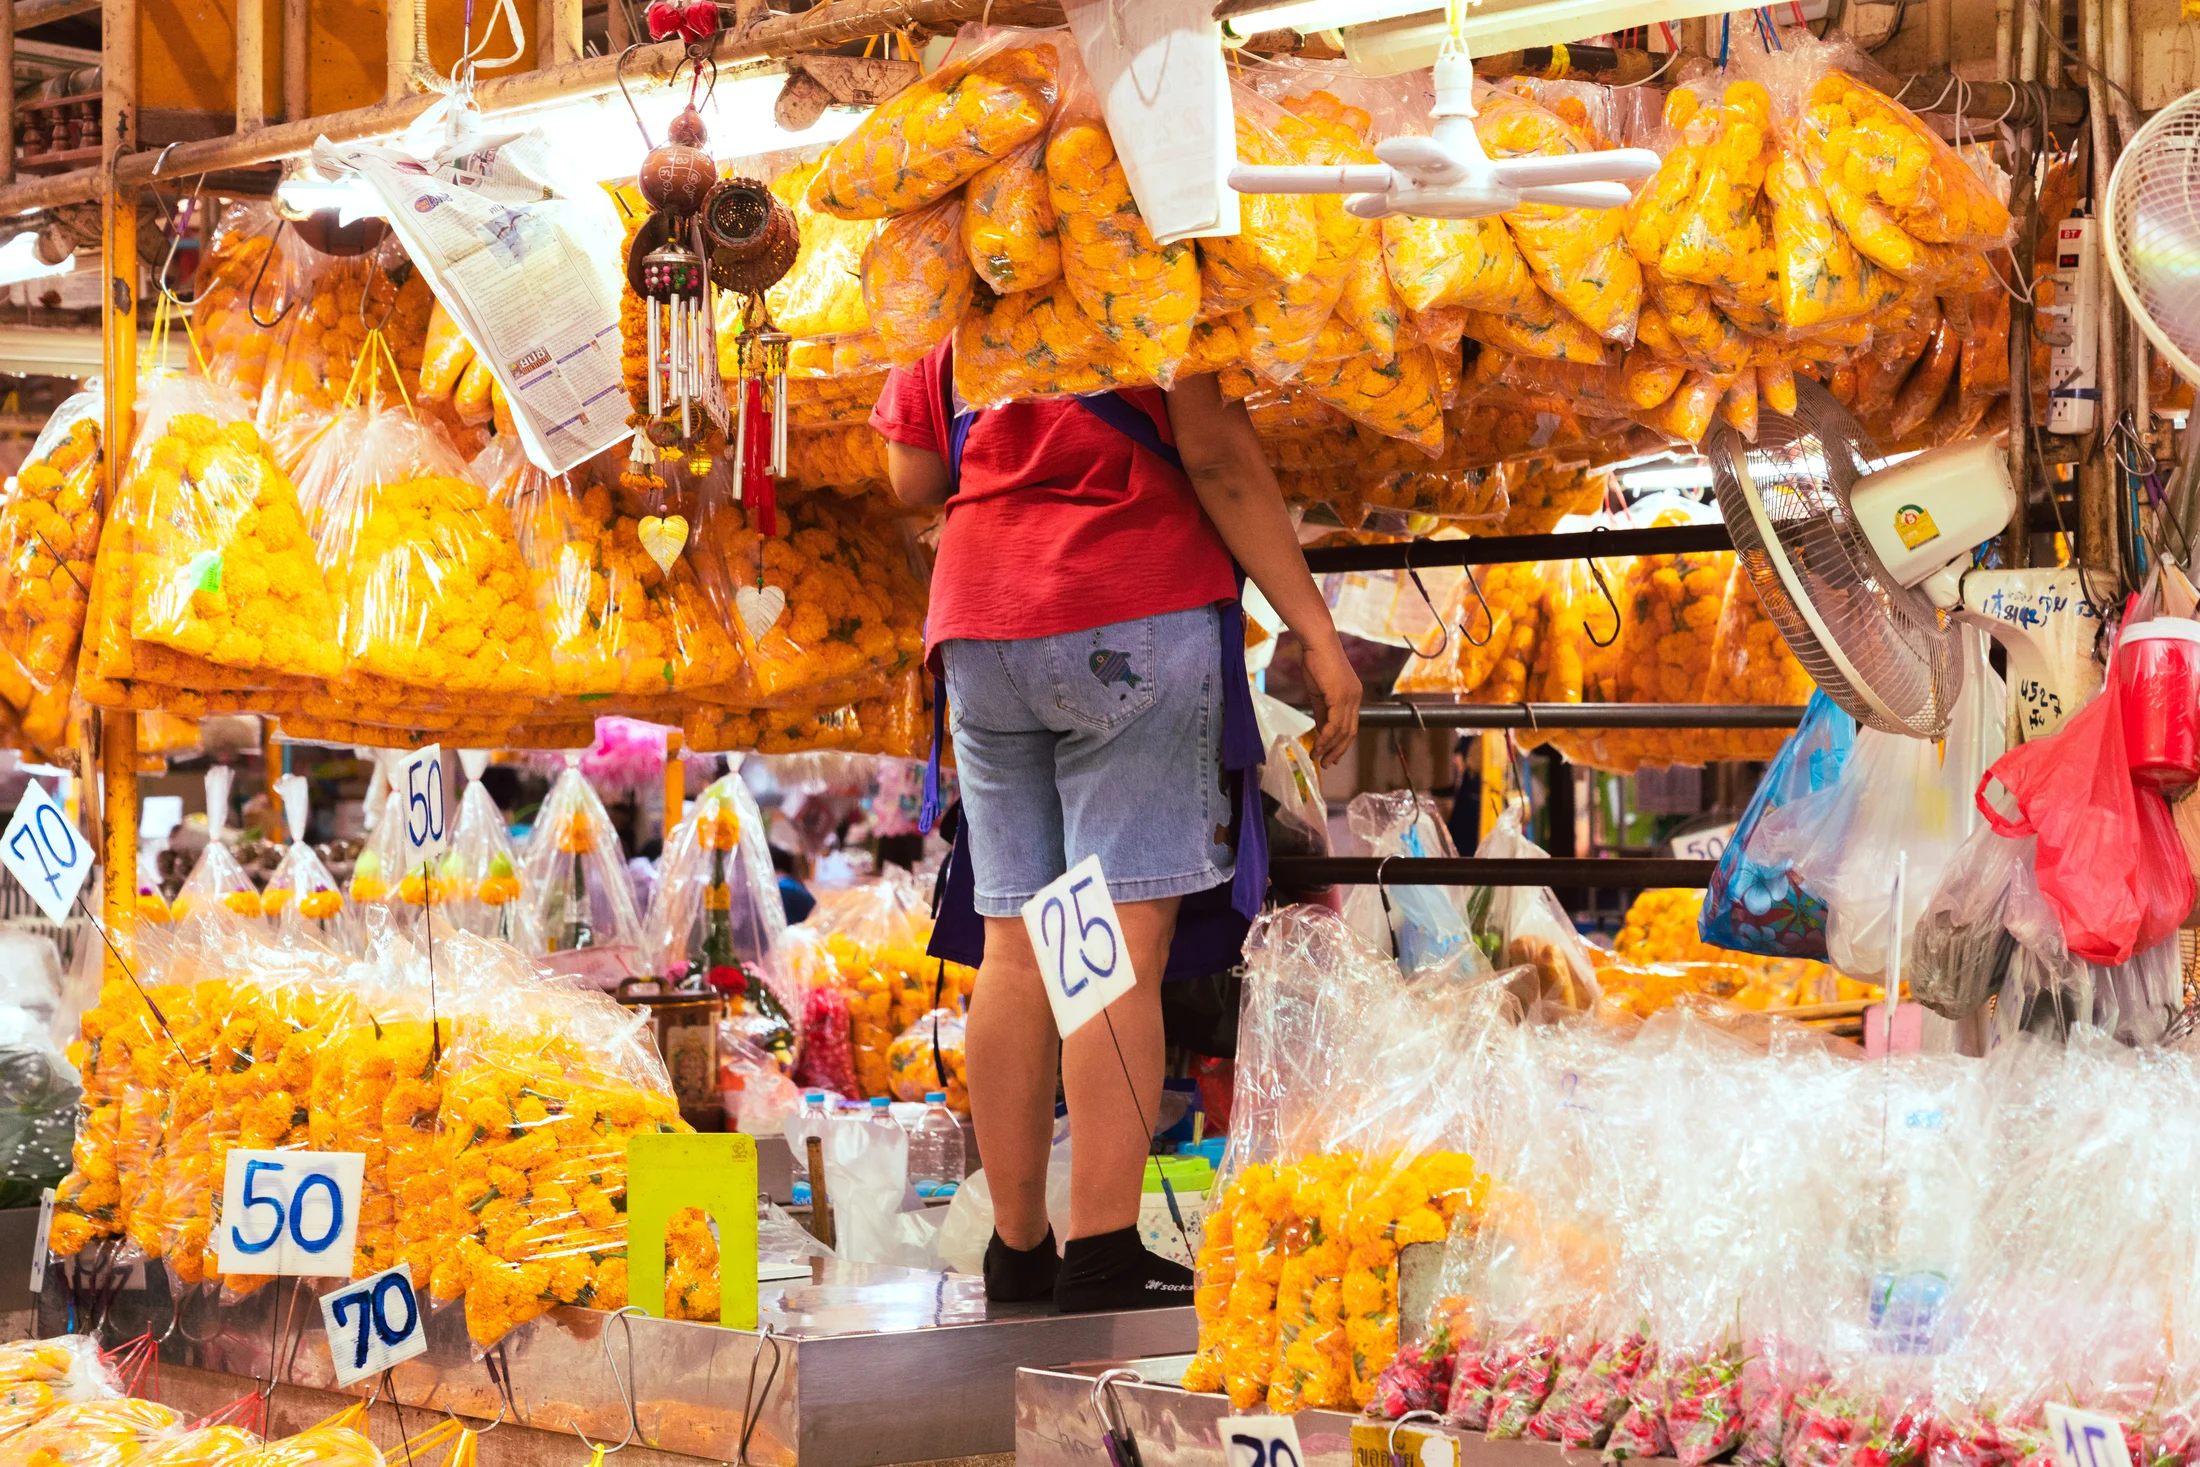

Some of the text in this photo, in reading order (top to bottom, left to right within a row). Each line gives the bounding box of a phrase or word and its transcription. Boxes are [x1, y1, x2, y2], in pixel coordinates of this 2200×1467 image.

[2063, 230, 2077, 239] BT
[2020, 679, 2062, 719] 4527
[408, 759, 444, 847] 50
[10, 804, 77, 901] 70
[1041, 875, 1117, 998] 25
[231, 1159, 344, 1255] 50
[332, 1272, 418, 1369] 70
